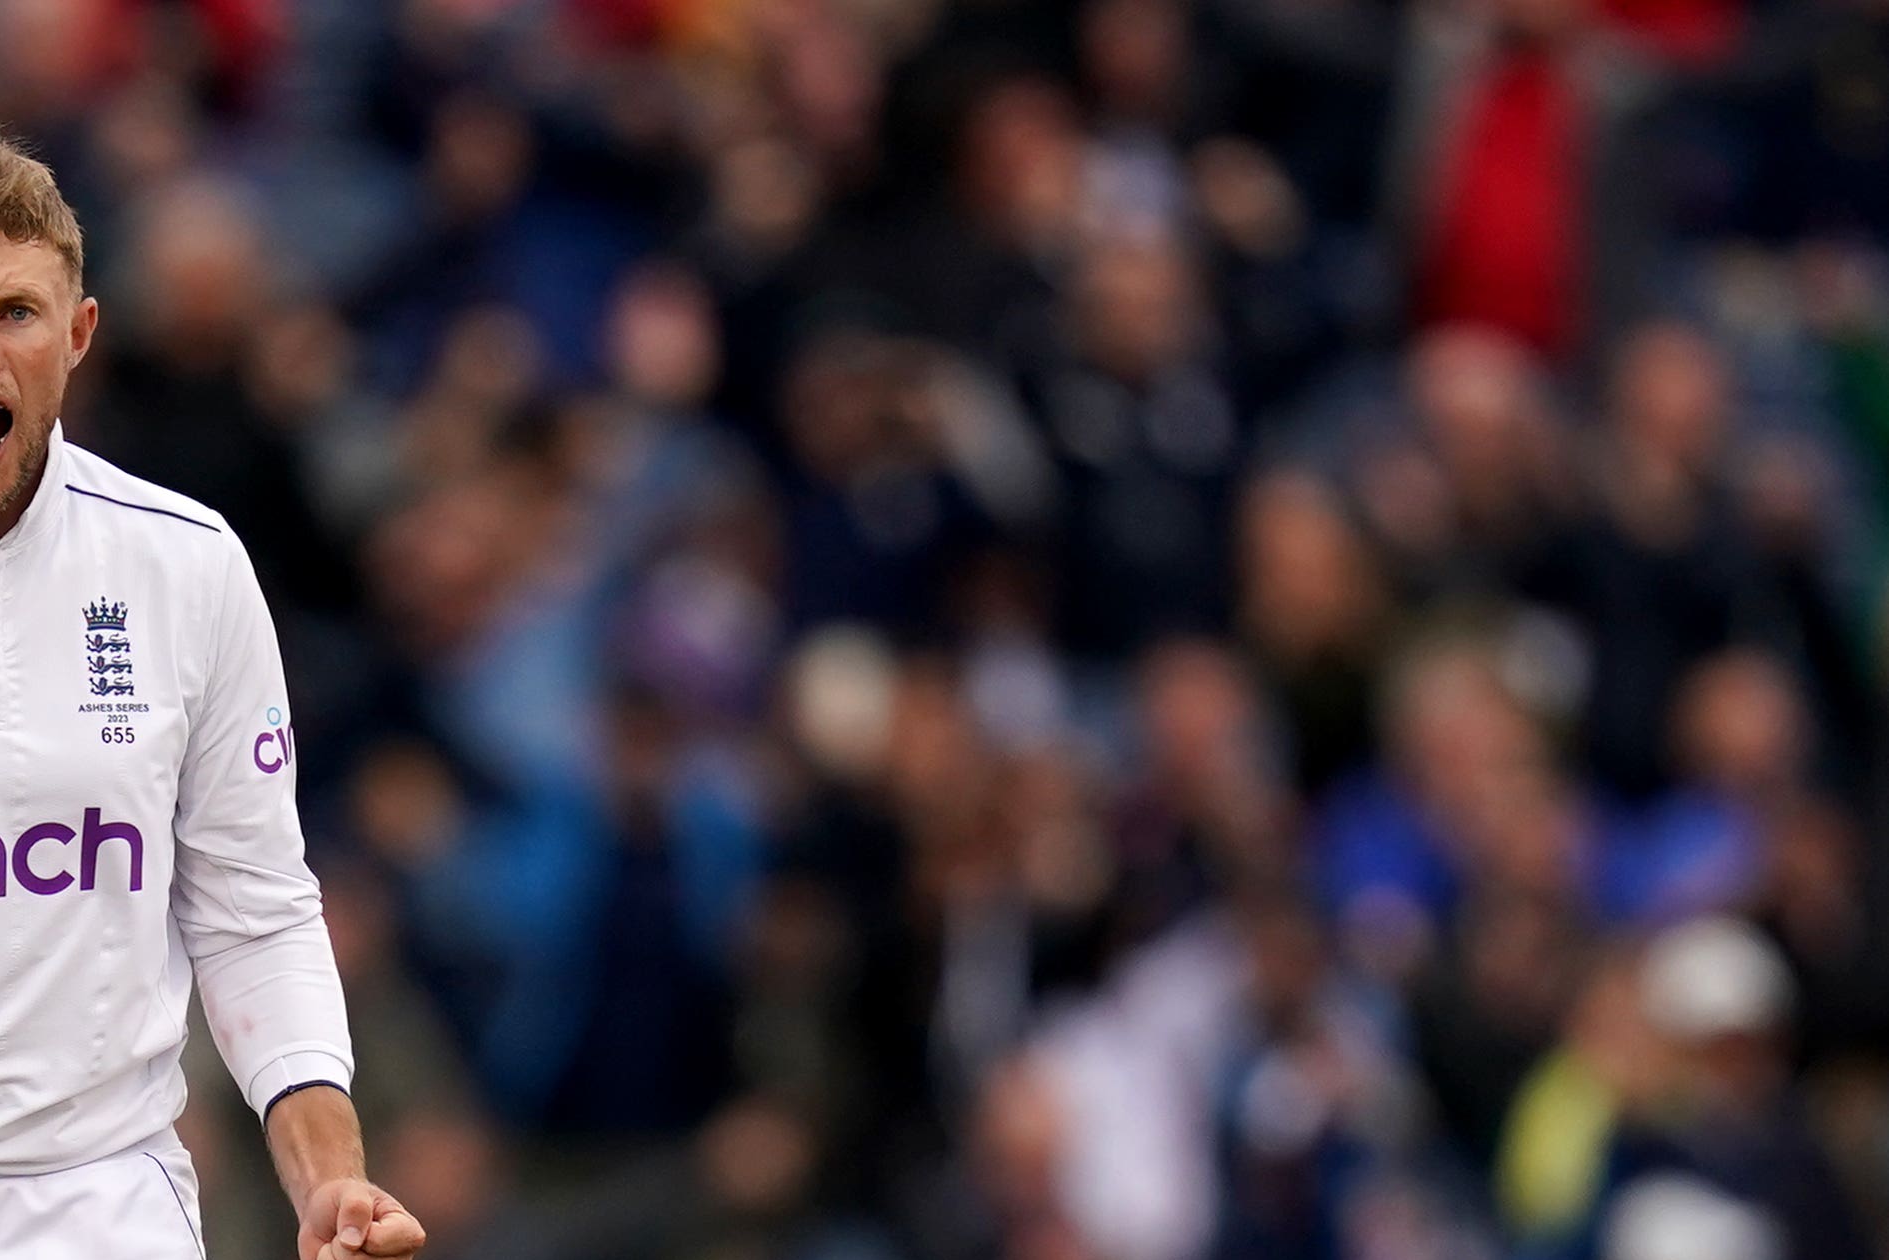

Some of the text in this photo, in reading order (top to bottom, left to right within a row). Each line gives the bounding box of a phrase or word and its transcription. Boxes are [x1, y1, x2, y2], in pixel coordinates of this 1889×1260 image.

[78, 703, 150, 713] ASHES SERIES
[107, 714, 129, 723] 2023
[101, 726, 135, 744] 655
